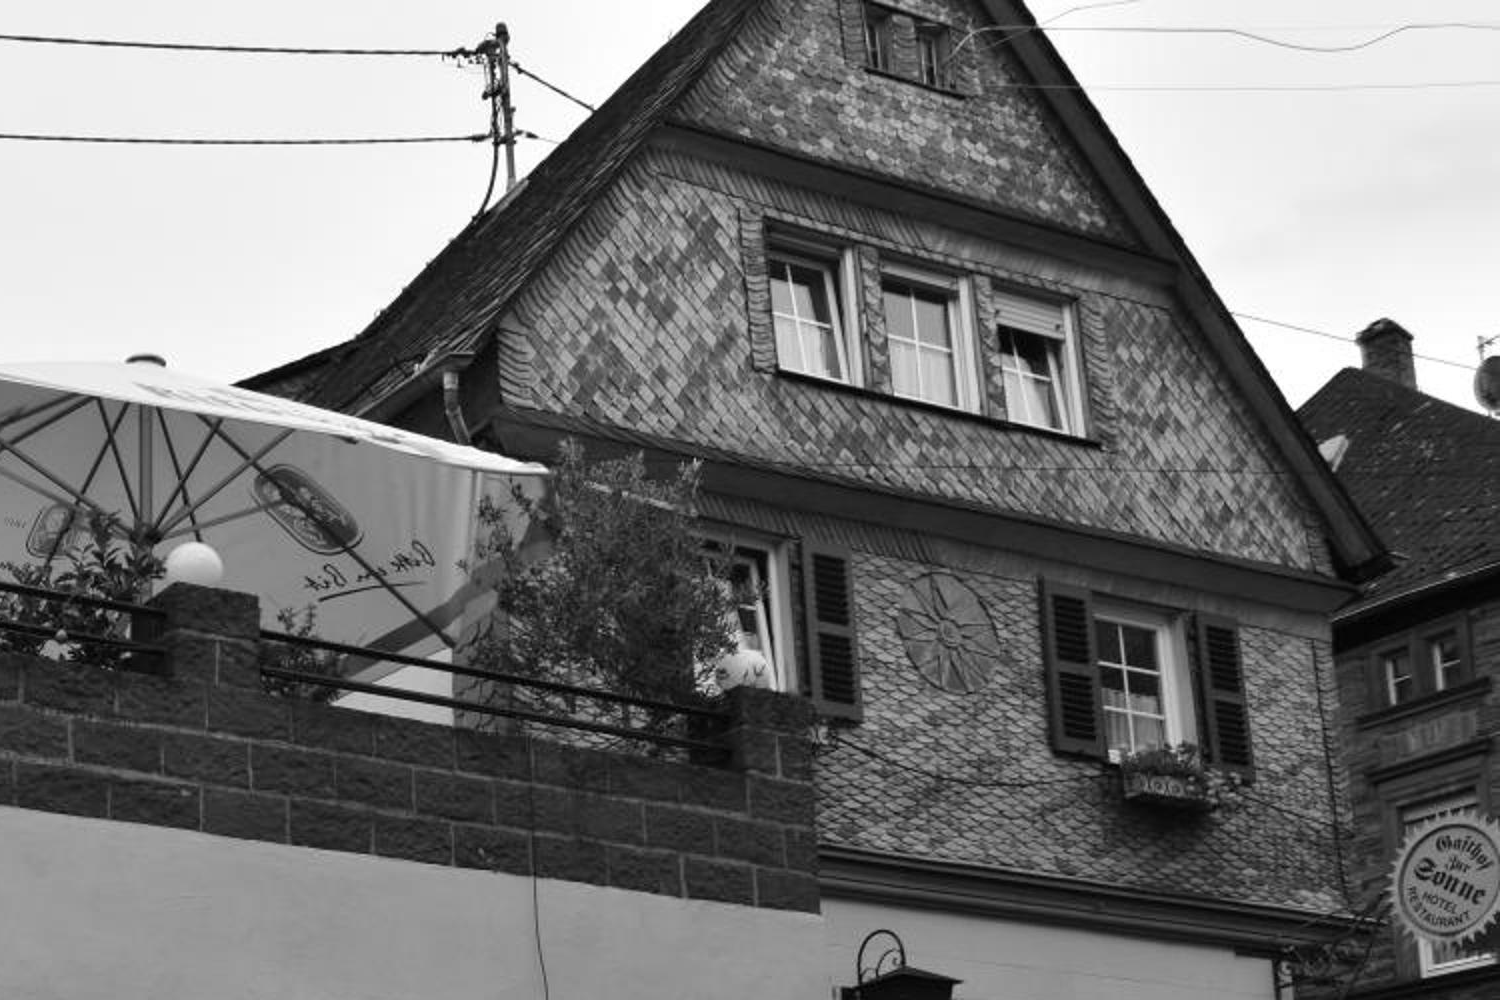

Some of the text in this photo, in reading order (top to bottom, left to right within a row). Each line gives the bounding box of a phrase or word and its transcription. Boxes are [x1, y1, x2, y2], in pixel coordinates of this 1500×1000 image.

[1414, 858, 1485, 904] Sonne
[1408, 886, 1469, 927] RESTAURANT
[1422, 891, 1458, 914] HOTEL
